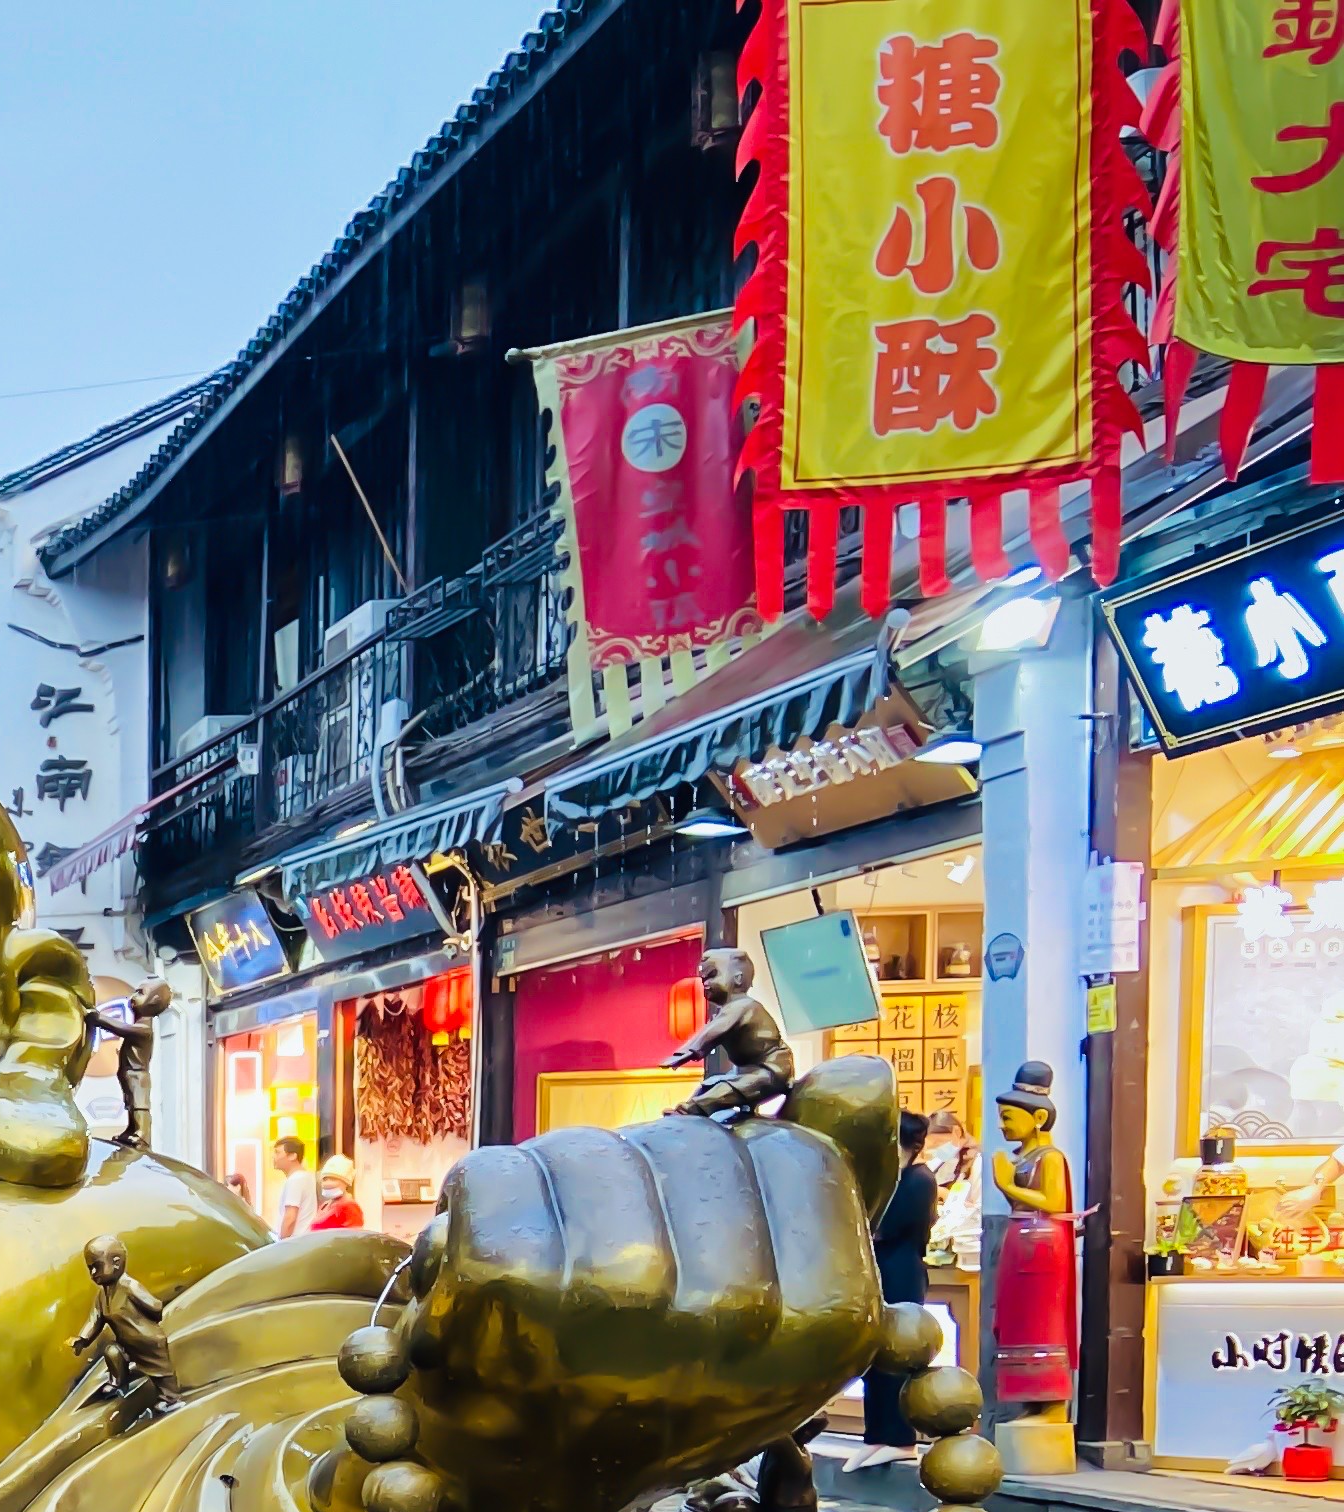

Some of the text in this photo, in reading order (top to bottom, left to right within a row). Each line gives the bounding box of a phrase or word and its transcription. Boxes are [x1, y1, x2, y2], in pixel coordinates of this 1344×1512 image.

[874, 32, 1002, 436] 糖小酥
[1211, 1328, 1344, 1374] 小时候
